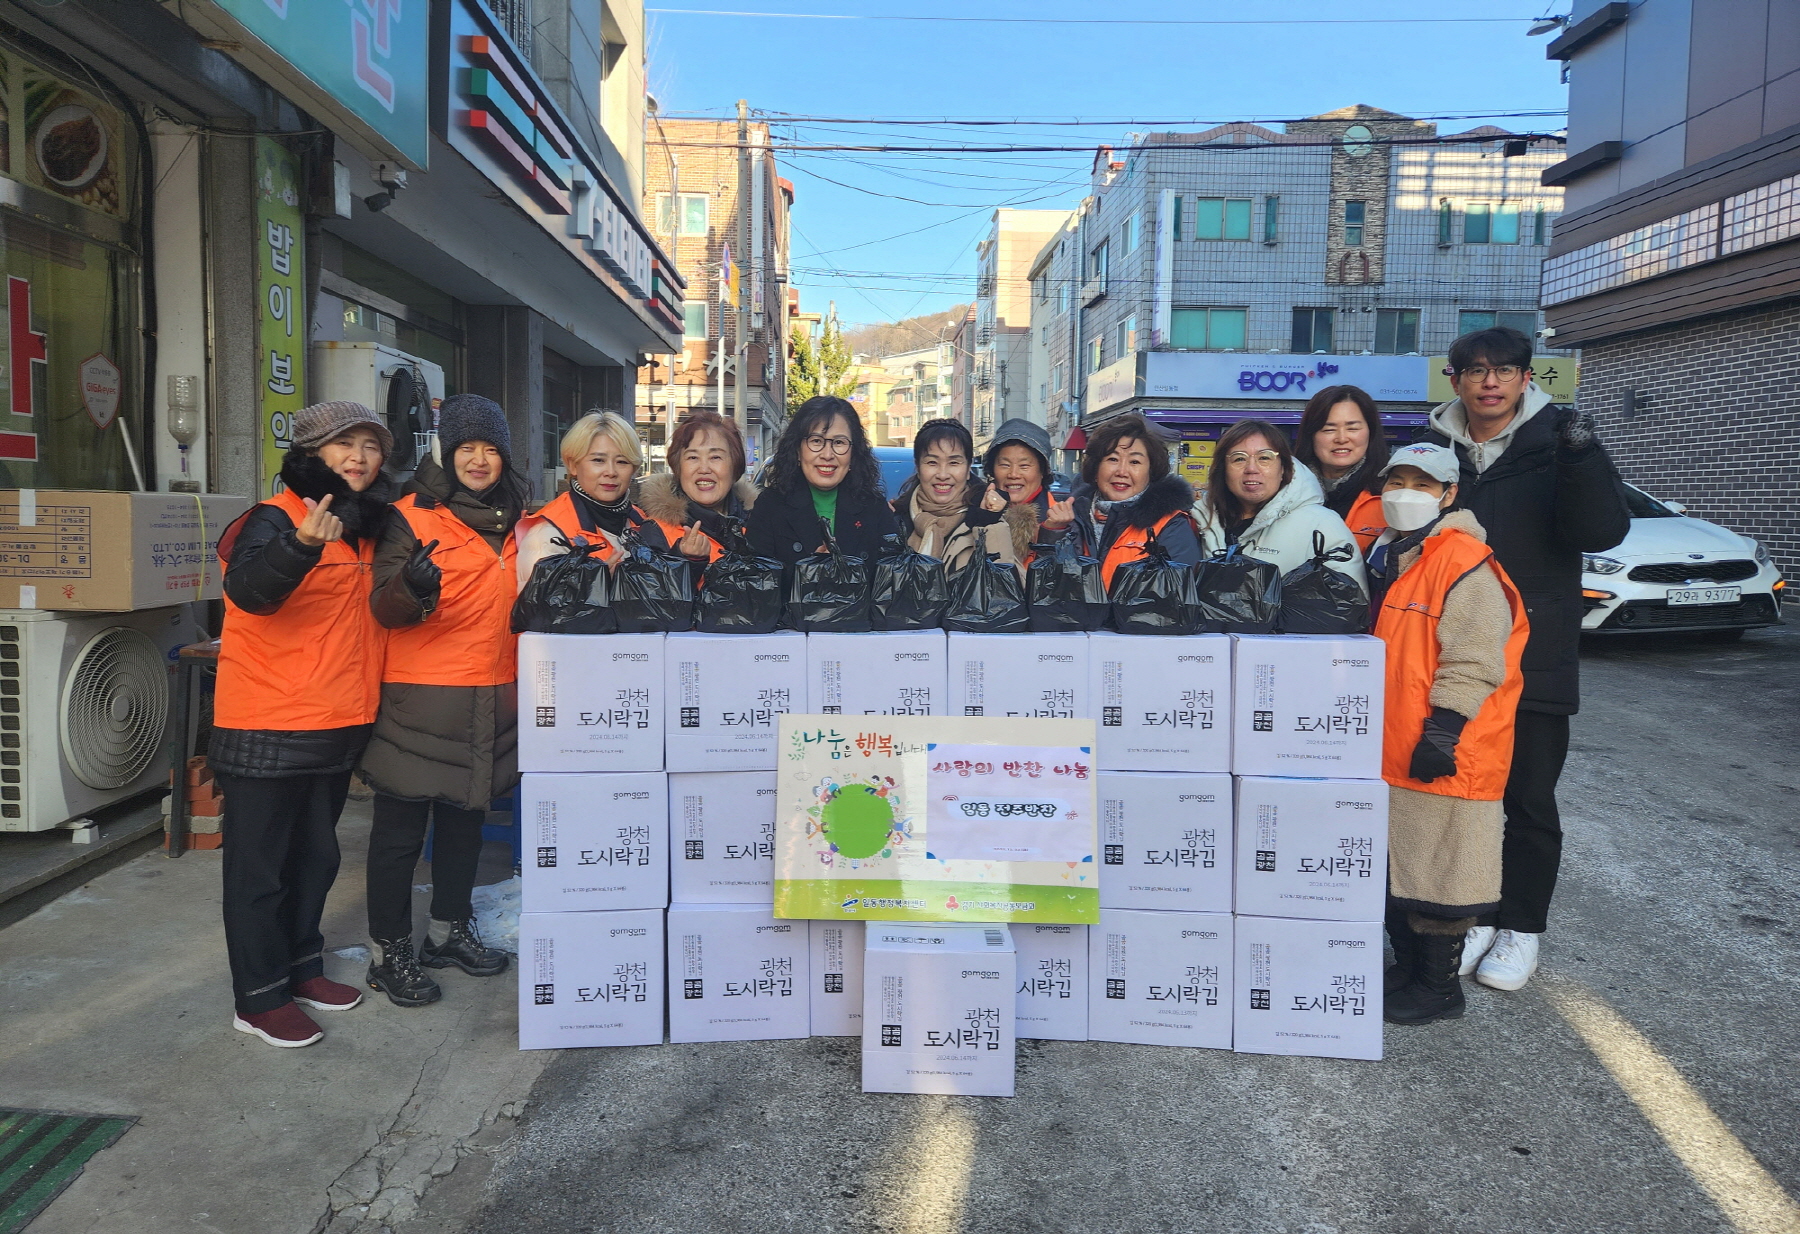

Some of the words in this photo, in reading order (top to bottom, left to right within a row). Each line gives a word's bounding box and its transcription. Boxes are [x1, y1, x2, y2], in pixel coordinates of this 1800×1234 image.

[1705, 590, 1734, 600] 9377
[613, 652, 648, 661] gomgom
[754, 654, 789, 662] gomgom
[895, 652, 929, 661] gomgom
[1038, 654, 1073, 662] gomgom
[1178, 655, 1213, 663] gomgom
[1332, 658, 1369, 667] gomgom
[616, 689, 649, 707] 광천
[757, 689, 789, 707] 광천
[898, 687, 930, 706] 광천
[1041, 689, 1073, 708] 광천
[1180, 690, 1213, 708] 광천
[1335, 695, 1368, 714] 광천
[577, 709, 648, 729] 도시락김
[1142, 710, 1212, 729] 도시락김
[1295, 715, 1367, 735] 도시락김
[804, 729, 851, 759] 나눔은
[932, 761, 993, 776] 사랑의
[1003, 761, 1044, 778] 반찬
[1053, 763, 1090, 779] 나눔
[614, 791, 649, 800] gomgom
[756, 788, 777, 797] gomg
[1179, 794, 1214, 802] gomgom
[1336, 800, 1373, 810] gomgom
[617, 825, 649, 845] 광천
[760, 822, 776, 842] 광
[1182, 829, 1215, 848] 광천
[578, 846, 649, 866] 도시락김
[1338, 837, 1372, 856] 광천
[1144, 849, 1214, 868] 도시락김
[1297, 857, 1371, 877] 도시락김
[610, 928, 646, 937] gomgom
[757, 924, 791, 933] gomgom
[1035, 925, 1071, 934] gomgom
[1182, 930, 1217, 939] gomgom
[1328, 939, 1365, 948] gomgom
[614, 962, 646, 982] 광천
[760, 957, 792, 977] 광천
[962, 970, 999, 979] gomgom
[1038, 958, 1071, 977] 광천
[1186, 966, 1217, 985] 광천
[575, 983, 646, 1002] 도시락김
[723, 977, 791, 997] 도시락김
[1331, 975, 1365, 994] 광천
[1146, 985, 1217, 1005] 도시락김
[1291, 994, 1364, 1015] 도시락김
[965, 1008, 1000, 1028] 광천
[924, 1029, 999, 1050] 도시락김
